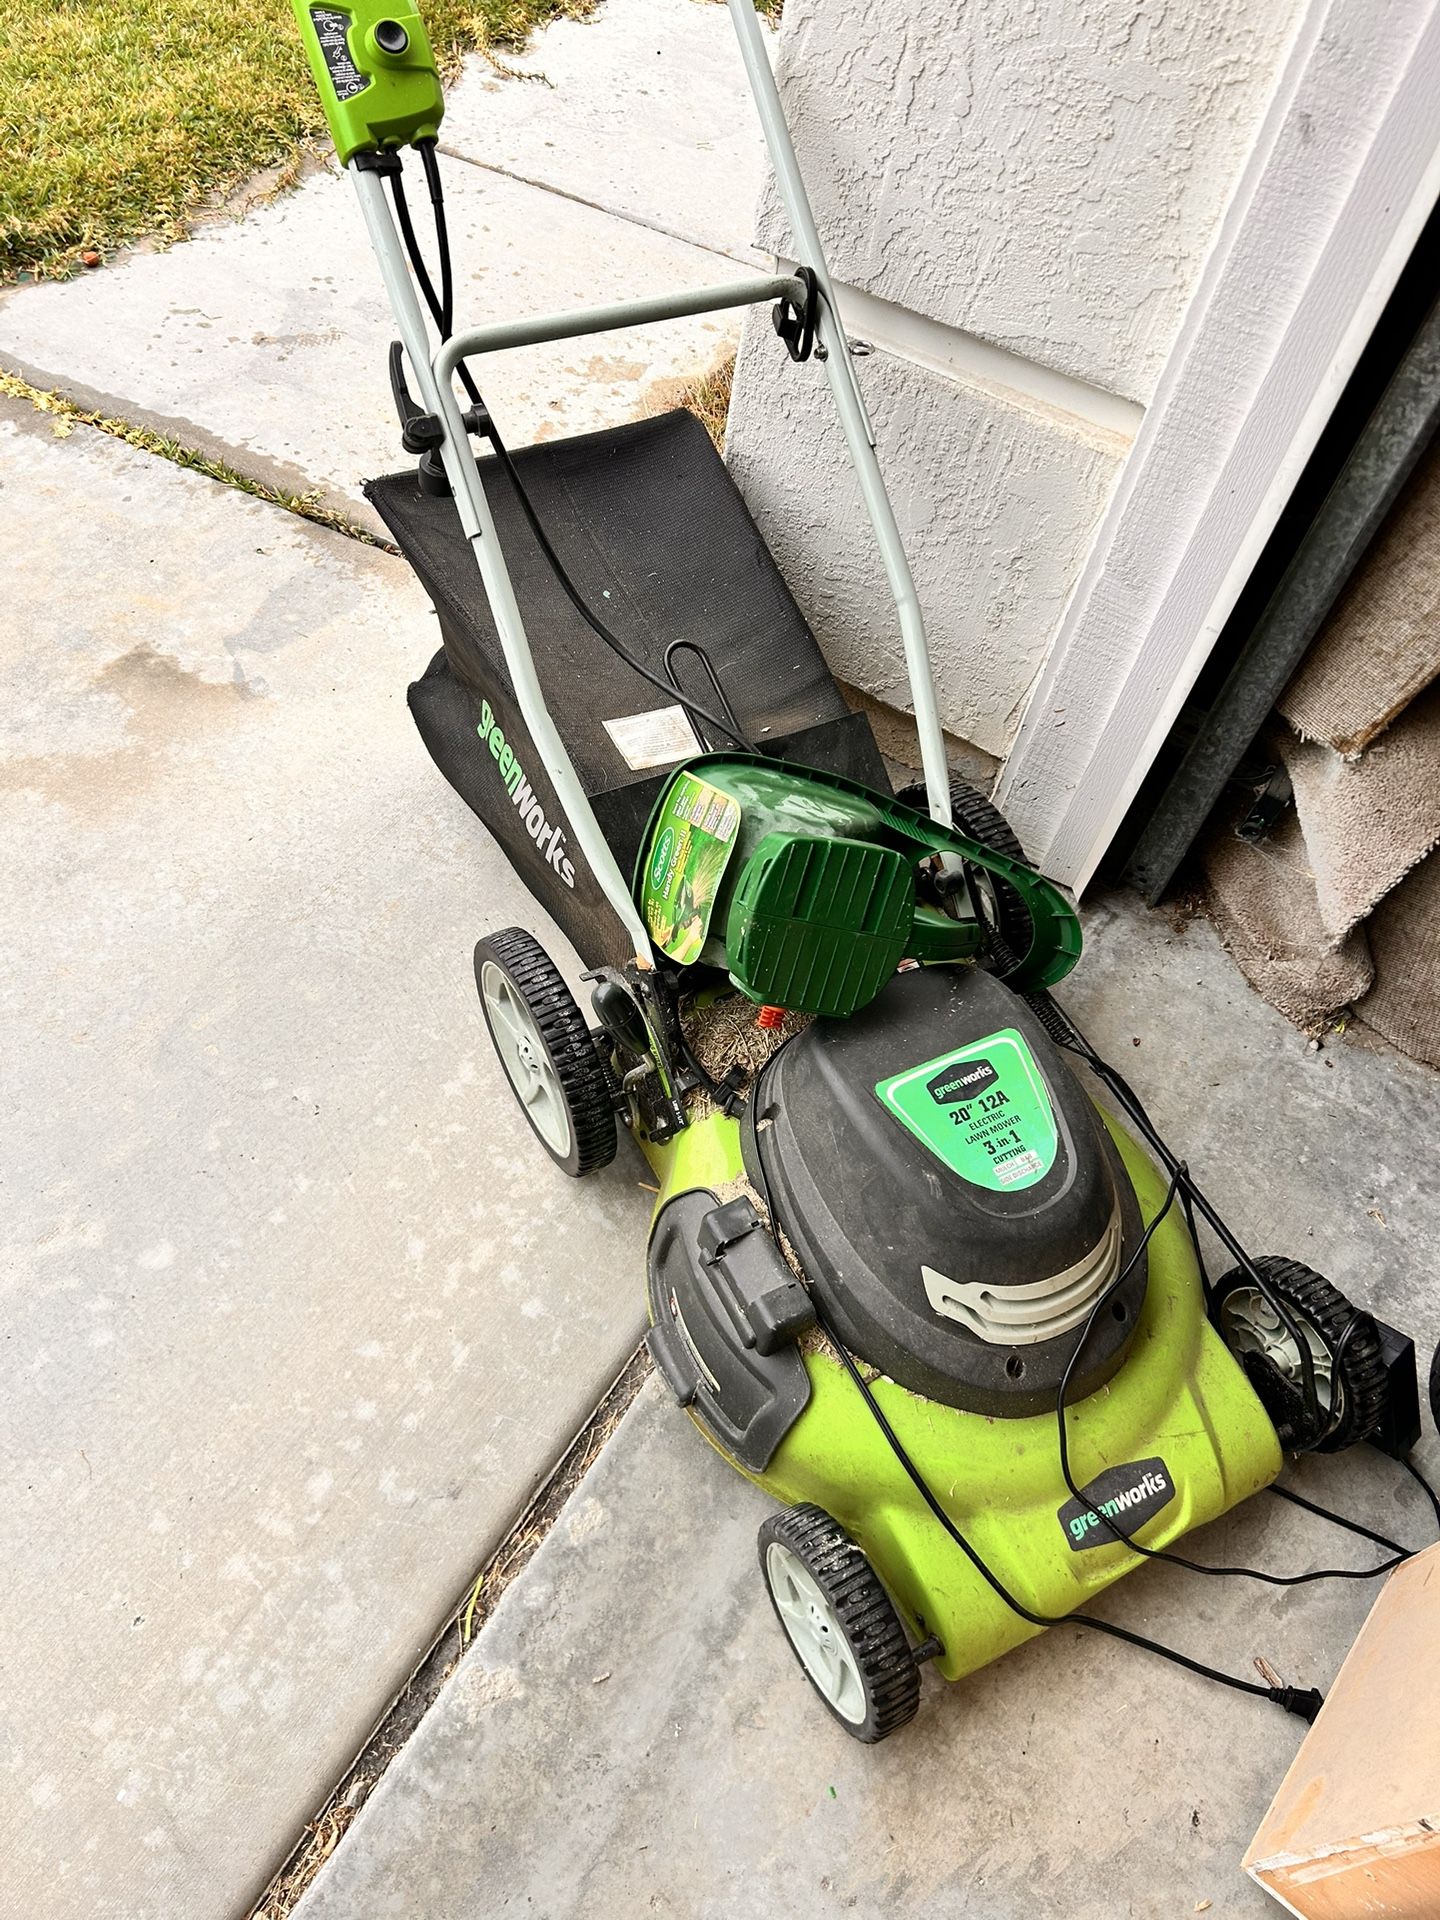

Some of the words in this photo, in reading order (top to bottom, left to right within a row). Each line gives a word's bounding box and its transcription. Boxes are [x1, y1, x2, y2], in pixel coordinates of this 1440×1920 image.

[477, 699, 575, 888] greenworks
[654, 835, 671, 882] Scotts
[662, 869, 674, 900] Handy
[671, 838, 683, 867] Green
[934, 1065, 993, 1099] greenworks
[949, 1103, 972, 1126] 20"
[978, 1090, 1010, 1113] 12A
[969, 1110, 1005, 1131] ELECTRIC
[965, 1129, 990, 1145] LAWN
[989, 1115, 1022, 1134] MOWER
[993, 1145, 1026, 1165] CUTTING
